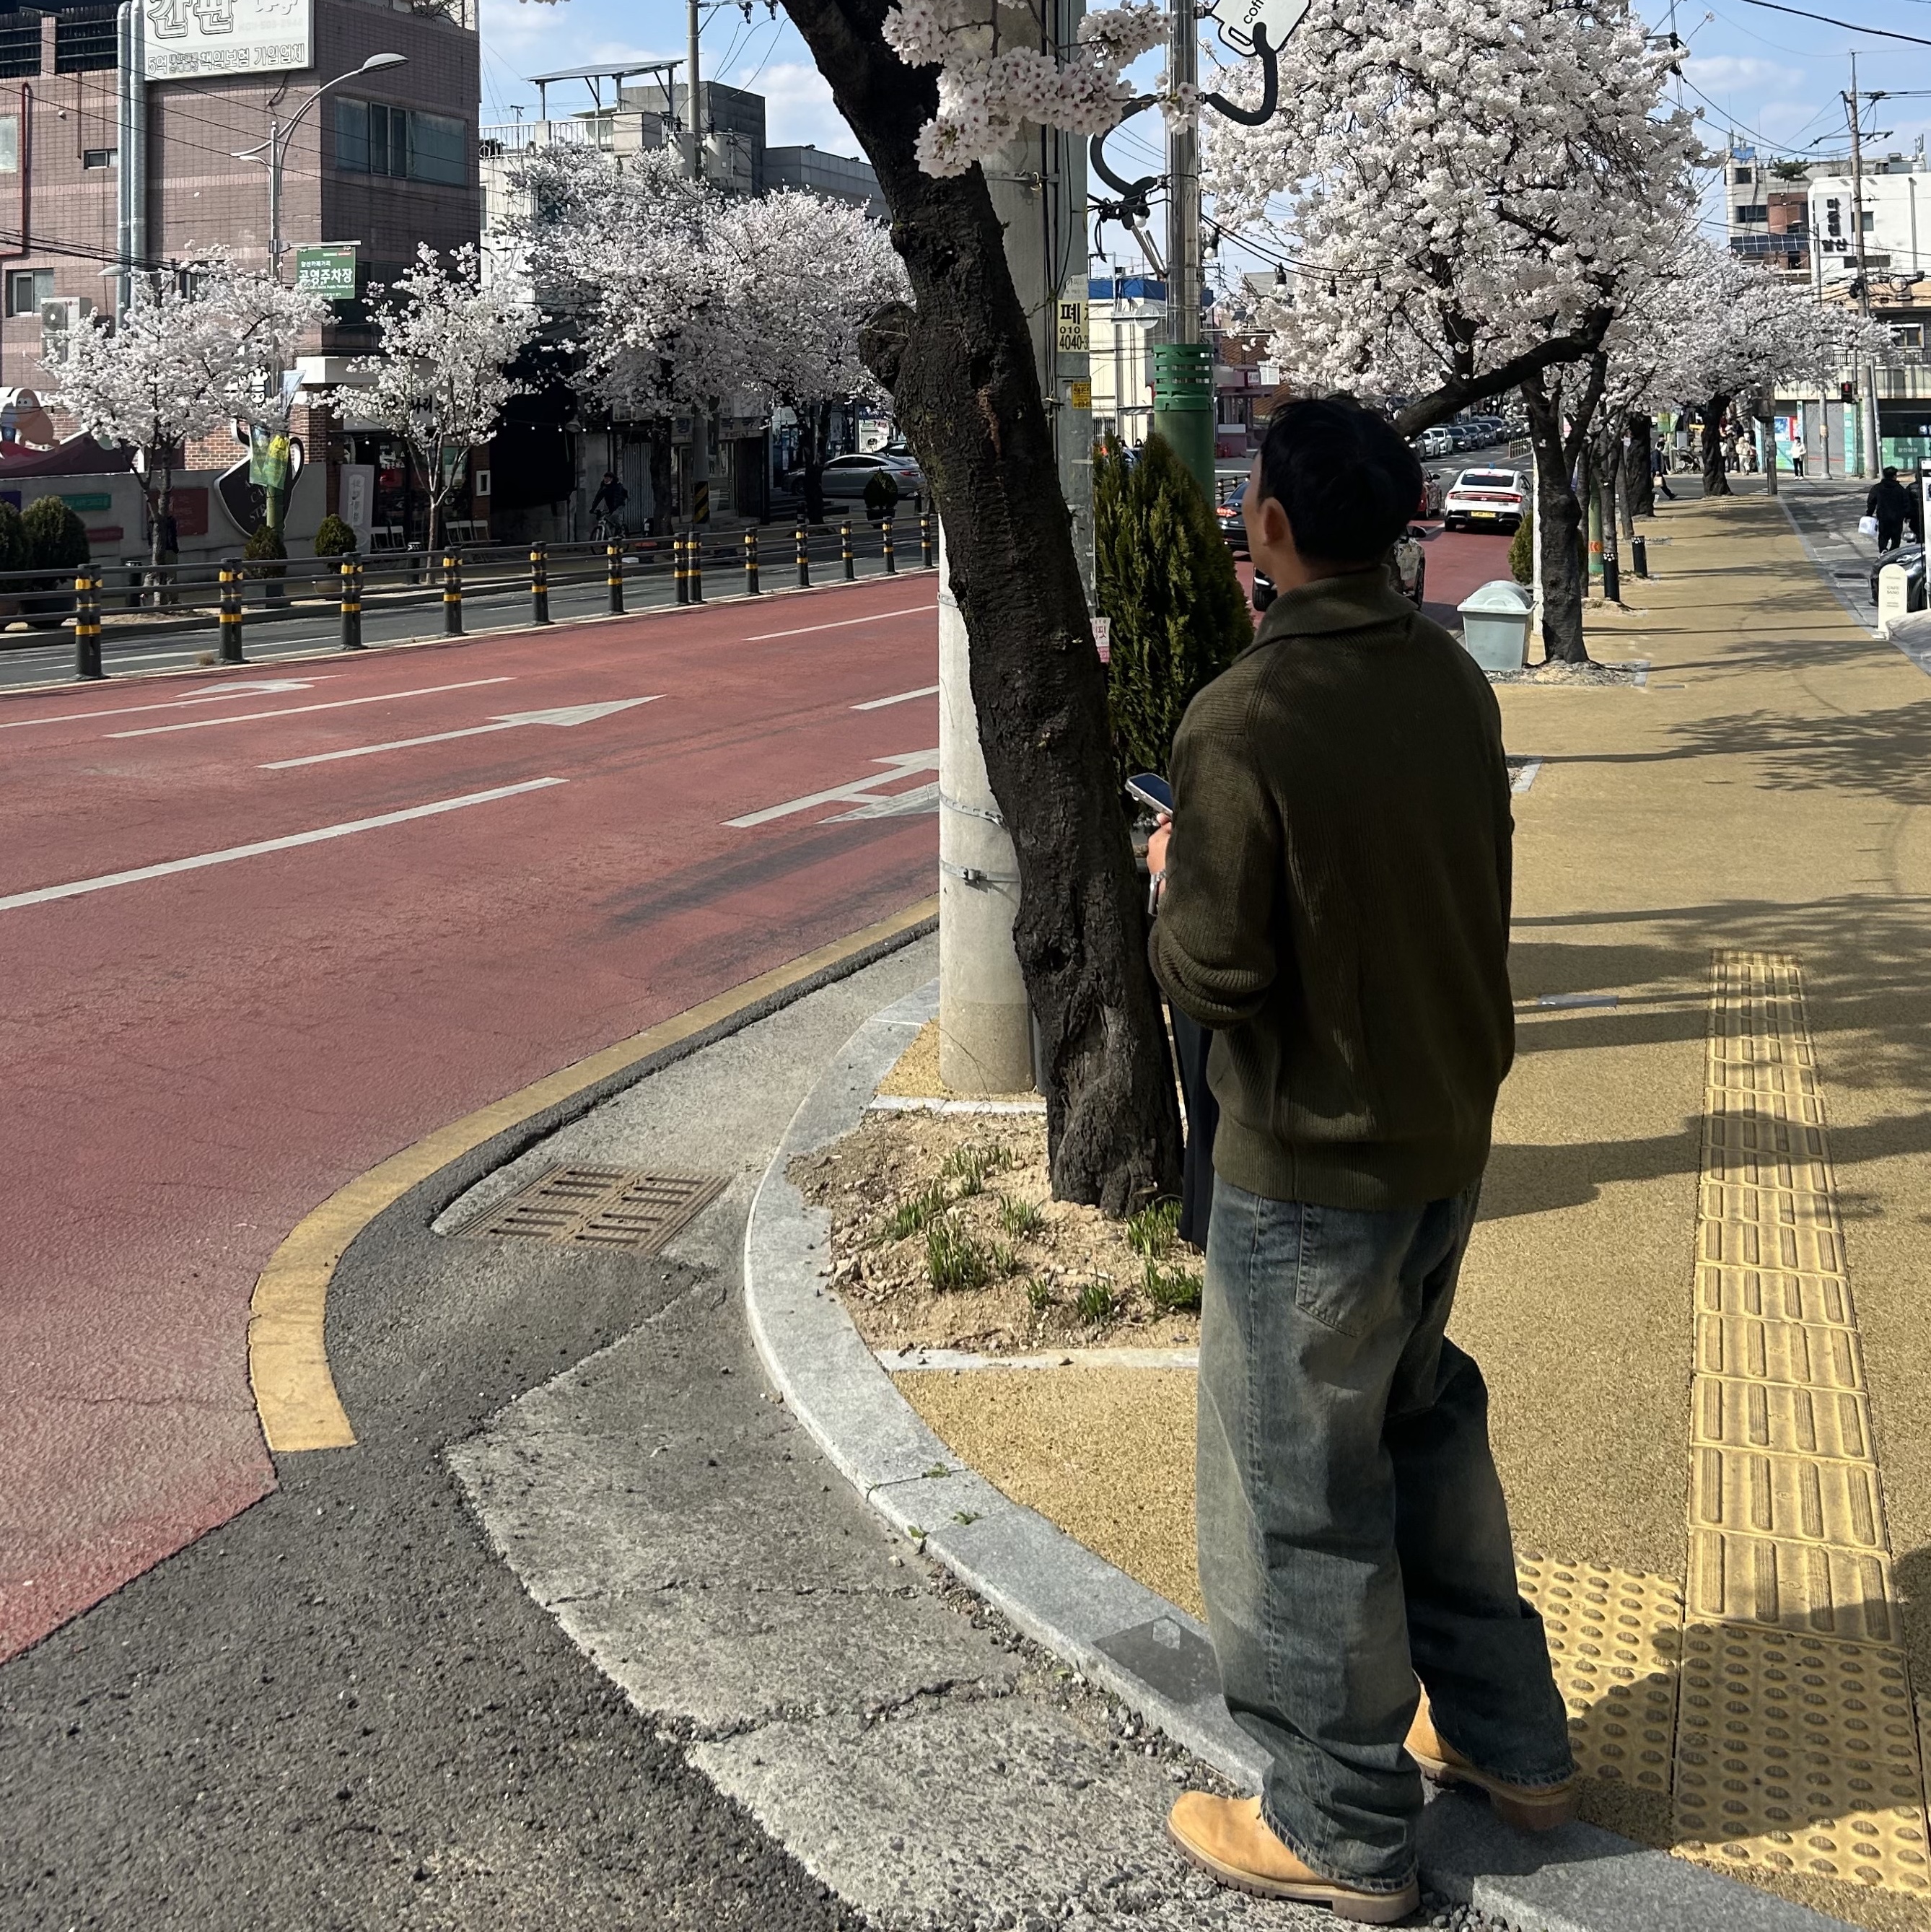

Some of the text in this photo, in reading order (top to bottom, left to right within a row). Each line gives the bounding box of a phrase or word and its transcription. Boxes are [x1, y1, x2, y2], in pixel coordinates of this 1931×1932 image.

[148, 55, 167, 74] 5억
[200, 47, 250, 70] 책임보험
[254, 43, 305, 66] 가입업체
[299, 268, 352, 284] 공영주차장
